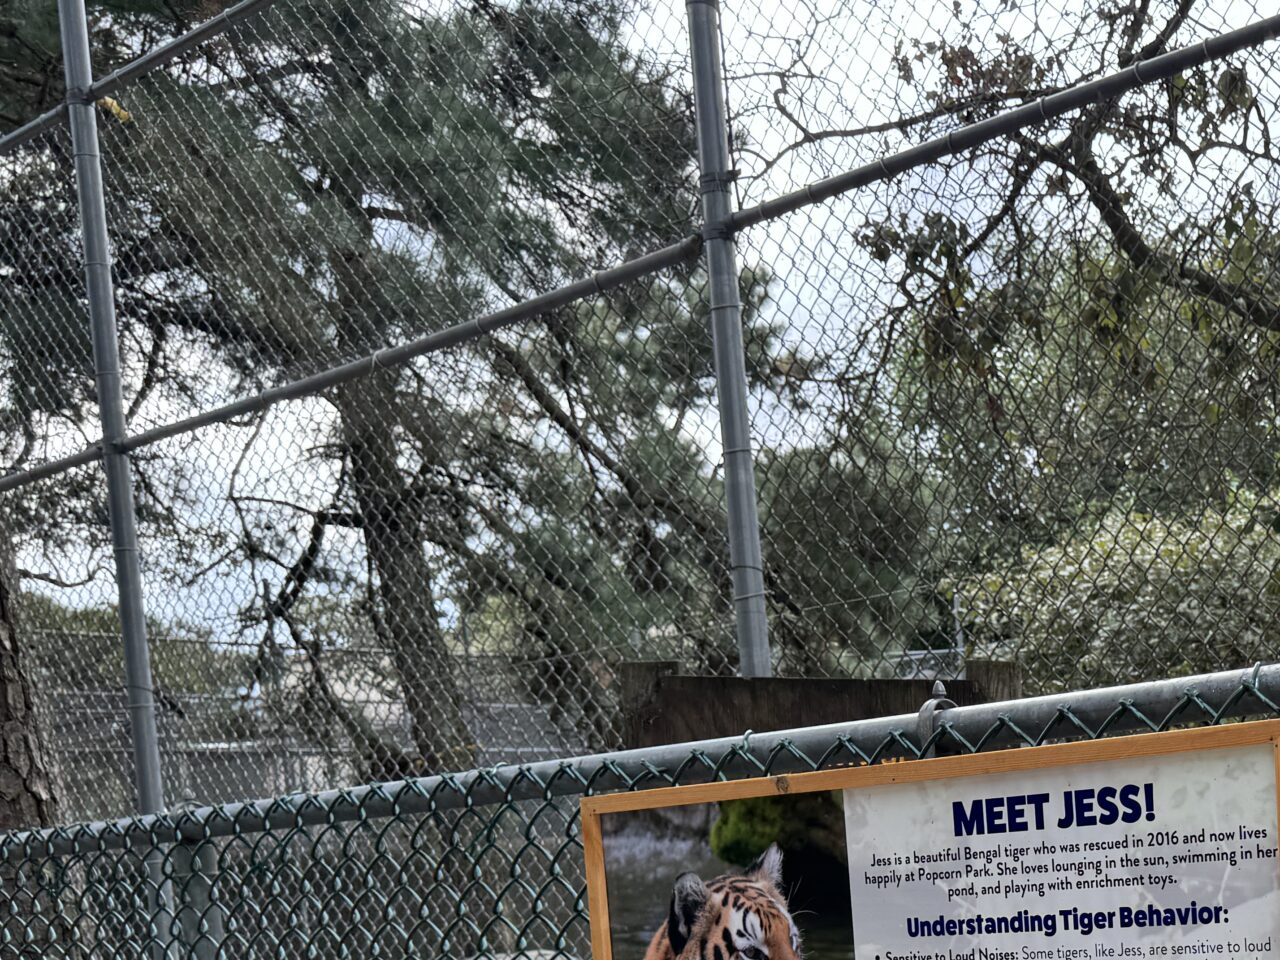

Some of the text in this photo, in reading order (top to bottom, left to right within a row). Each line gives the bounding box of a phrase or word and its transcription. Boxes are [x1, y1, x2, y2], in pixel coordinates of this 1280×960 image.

[952, 782, 1155, 837] MEET JESS!
[864, 843, 1278, 888] happily at Popcorn Park. She loves lounging in the sun, swimming in her
[870, 824, 1267, 867] Jess is a beautiful Bengal tiger who was rescued in 2016 and now lives
[947, 873, 1177, 901] pond, and playing with enrichment toys.
[906, 900, 1229, 938] Understanding Tiger Behavior:
[1021, 945, 1054, 960] Some
[1094, 943, 1115, 957] like
[1117, 942, 1146, 959] Jess,
[1149, 945, 1168, 956] are
[1170, 939, 1224, 955] sensitive
[1227, 941, 1240, 953] to
[1244, 936, 1271, 952] loud
